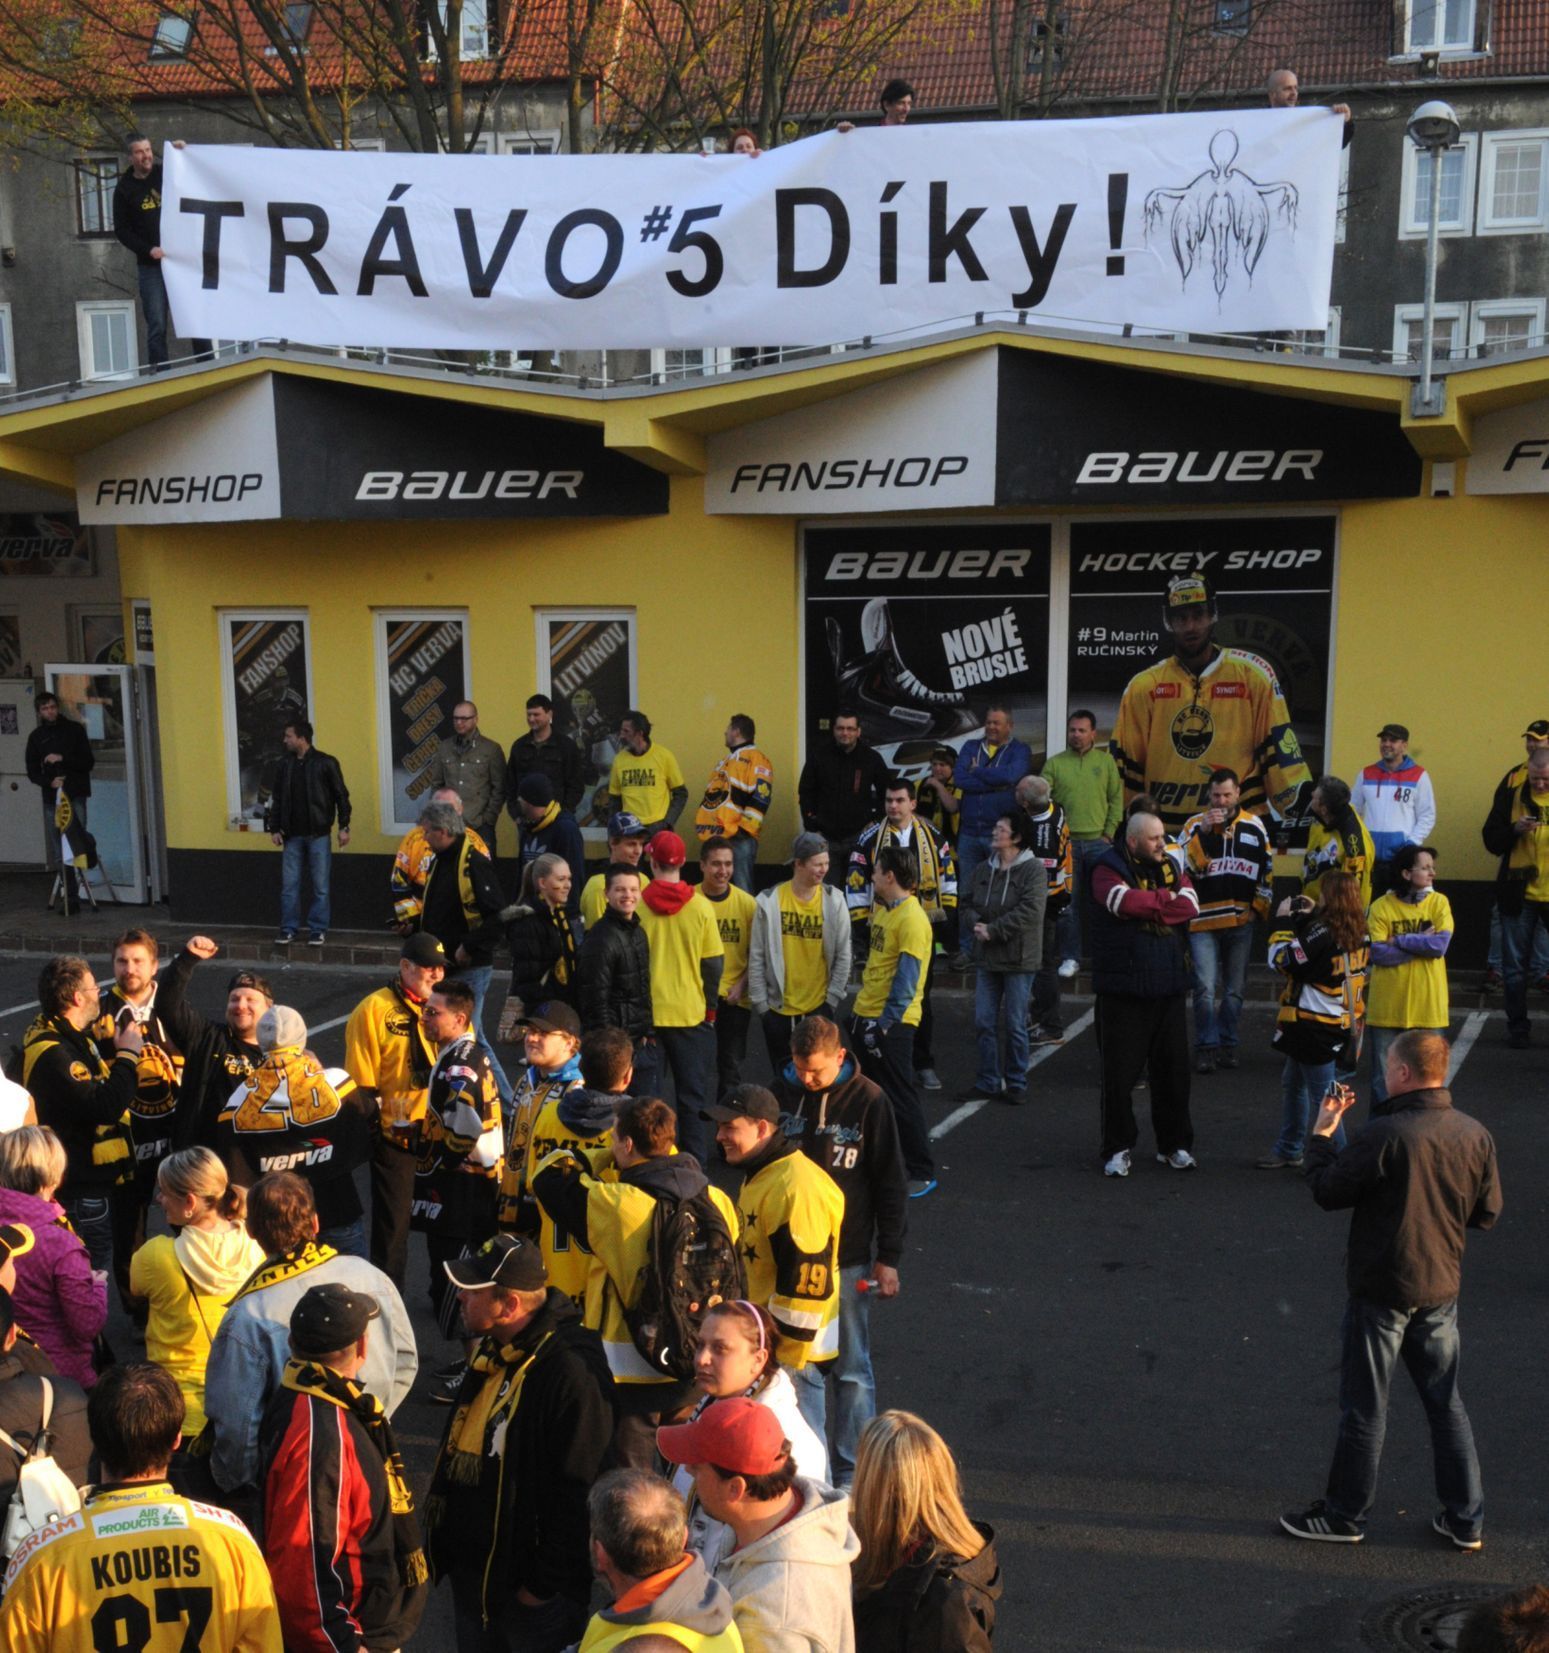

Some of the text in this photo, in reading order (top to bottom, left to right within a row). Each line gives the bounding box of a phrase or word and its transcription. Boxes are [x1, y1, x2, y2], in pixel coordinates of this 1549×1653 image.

[179, 183, 624, 300] TRÁVO
[95, 472, 264, 506] FANSHOP
[730, 455, 969, 494] FANSHOP
[1078, 549, 1322, 573] HOCKEY SHOP
[941, 606, 1023, 665] NOVÉ
[1076, 627, 1160, 643] #9 Martin
[1076, 643, 1158, 656] RUČINSKÝ
[238, 622, 301, 694] FANSHOP
[389, 620, 463, 697] HC VERVA
[950, 647, 1029, 690] BRUSLE
[621, 768, 656, 780] FINAL
[780, 911, 823, 929] FINAL
[260, 1144, 334, 1173] verva
[831, 1145, 859, 1170] 78
[795, 1261, 829, 1297] 19
[98, 1517, 161, 1536] PRODUCTS
[138, 1508, 159, 1518] AIR
[7, 1516, 77, 1580] OSRAM
[90, 1544, 201, 1591] KOUBIS
